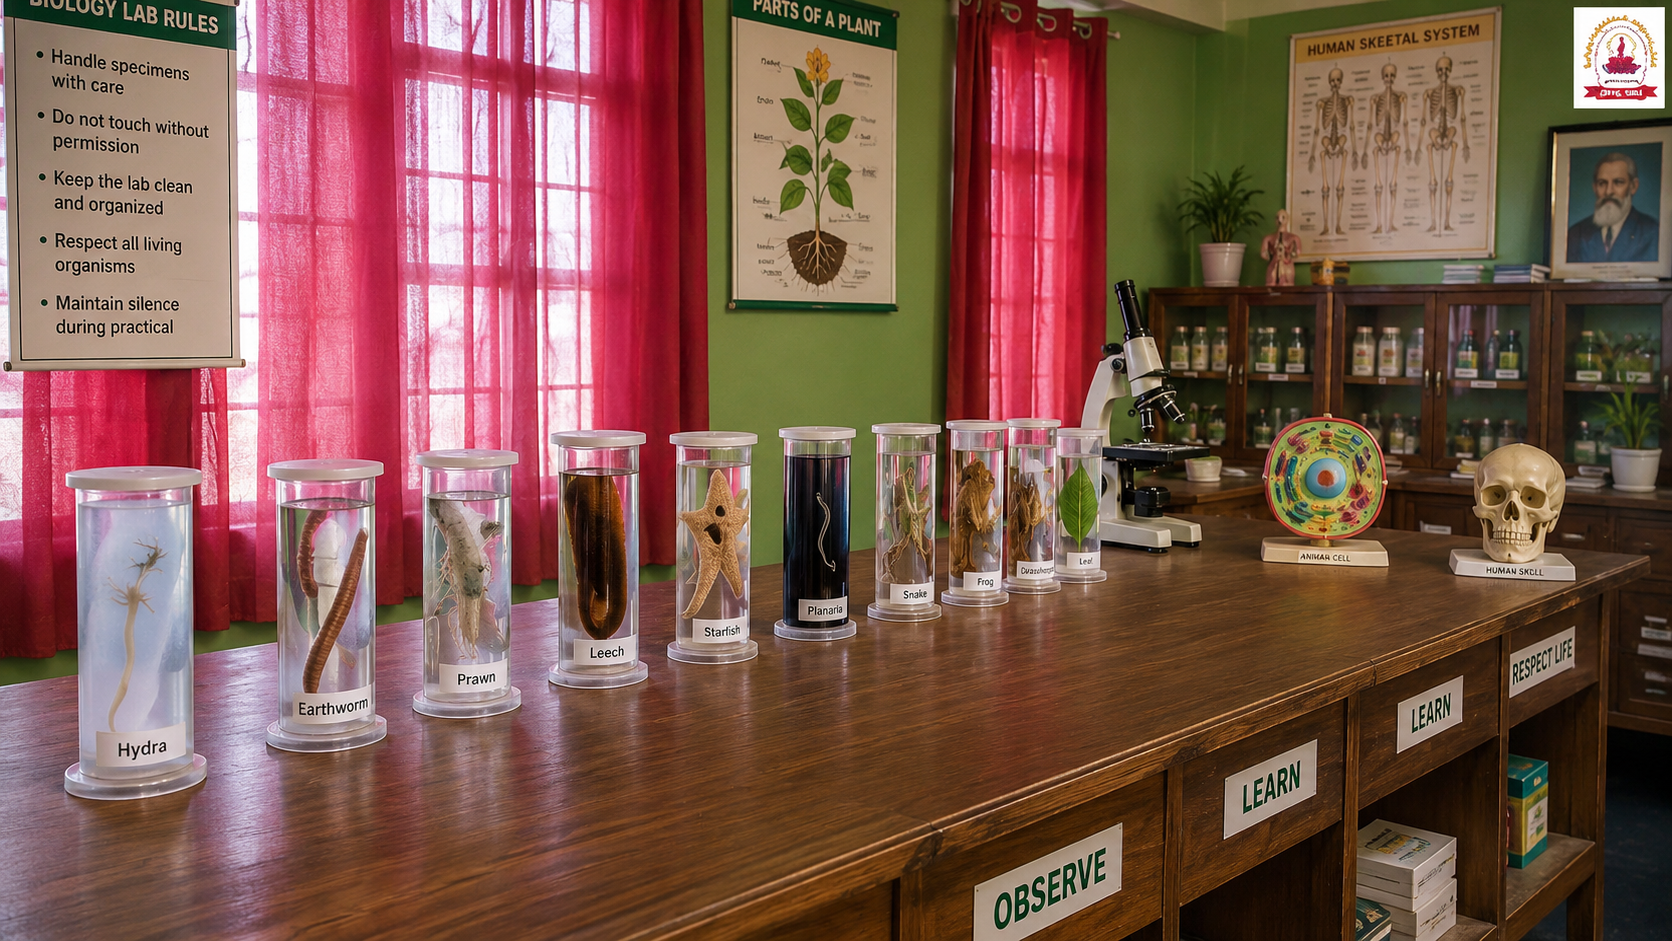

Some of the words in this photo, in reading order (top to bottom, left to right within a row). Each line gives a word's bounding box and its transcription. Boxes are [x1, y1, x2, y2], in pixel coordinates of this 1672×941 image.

[123, 1, 159, 25] LAB
[163, 8, 219, 35] RULES
[753, 0, 799, 20] PARTS
[803, 5, 822, 24] OF
[824, 10, 835, 28] A
[838, 13, 882, 38] PLANT
[1307, 39, 1355, 57] HUMAN
[1359, 31, 1419, 50] SKEETAL
[1423, 23, 1480, 43] SYSTEM
[51, 48, 107, 70] Handle
[111, 60, 190, 81] specimens
[51, 73, 86, 91] with
[90, 80, 125, 95] care
[52, 108, 75, 125] Do
[79, 114, 105, 129] not
[108, 115, 151, 133] touch
[155, 120, 210, 139] without
[52, 135, 139, 154] permission
[54, 169, 94, 191] Keep
[97, 173, 124, 190] the
[127, 174, 150, 192] lab
[154, 177, 193, 194] clean
[54, 194, 84, 211] and
[88, 198, 164, 217] organized
[55, 232, 118, 253] Respect
[121, 235, 139, 251] all
[144, 236, 182, 256] living
[55, 257, 136, 277] organisms
[56, 294, 124, 311] Maintain
[128, 295, 180, 312] silence
[55, 318, 106, 338] during
[110, 318, 174, 338] practical
[1486, 566, 1517, 575] HUMAN
[977, 577, 994, 588] Frog
[903, 589, 928, 600] Snake
[807, 604, 843, 616] Planaria
[704, 624, 741, 638] Starfish
[590, 645, 625, 659] Leech
[1512, 647, 1553, 685] RESPECT
[1554, 637, 1574, 665] LIFE
[457, 673, 496, 686] Prawn
[298, 698, 369, 717] Earthworm
[1411, 692, 1452, 734] LEARN
[118, 739, 167, 761] Hydra
[1242, 759, 1302, 815] LEARN
[993, 847, 1107, 930] OBSERVE
